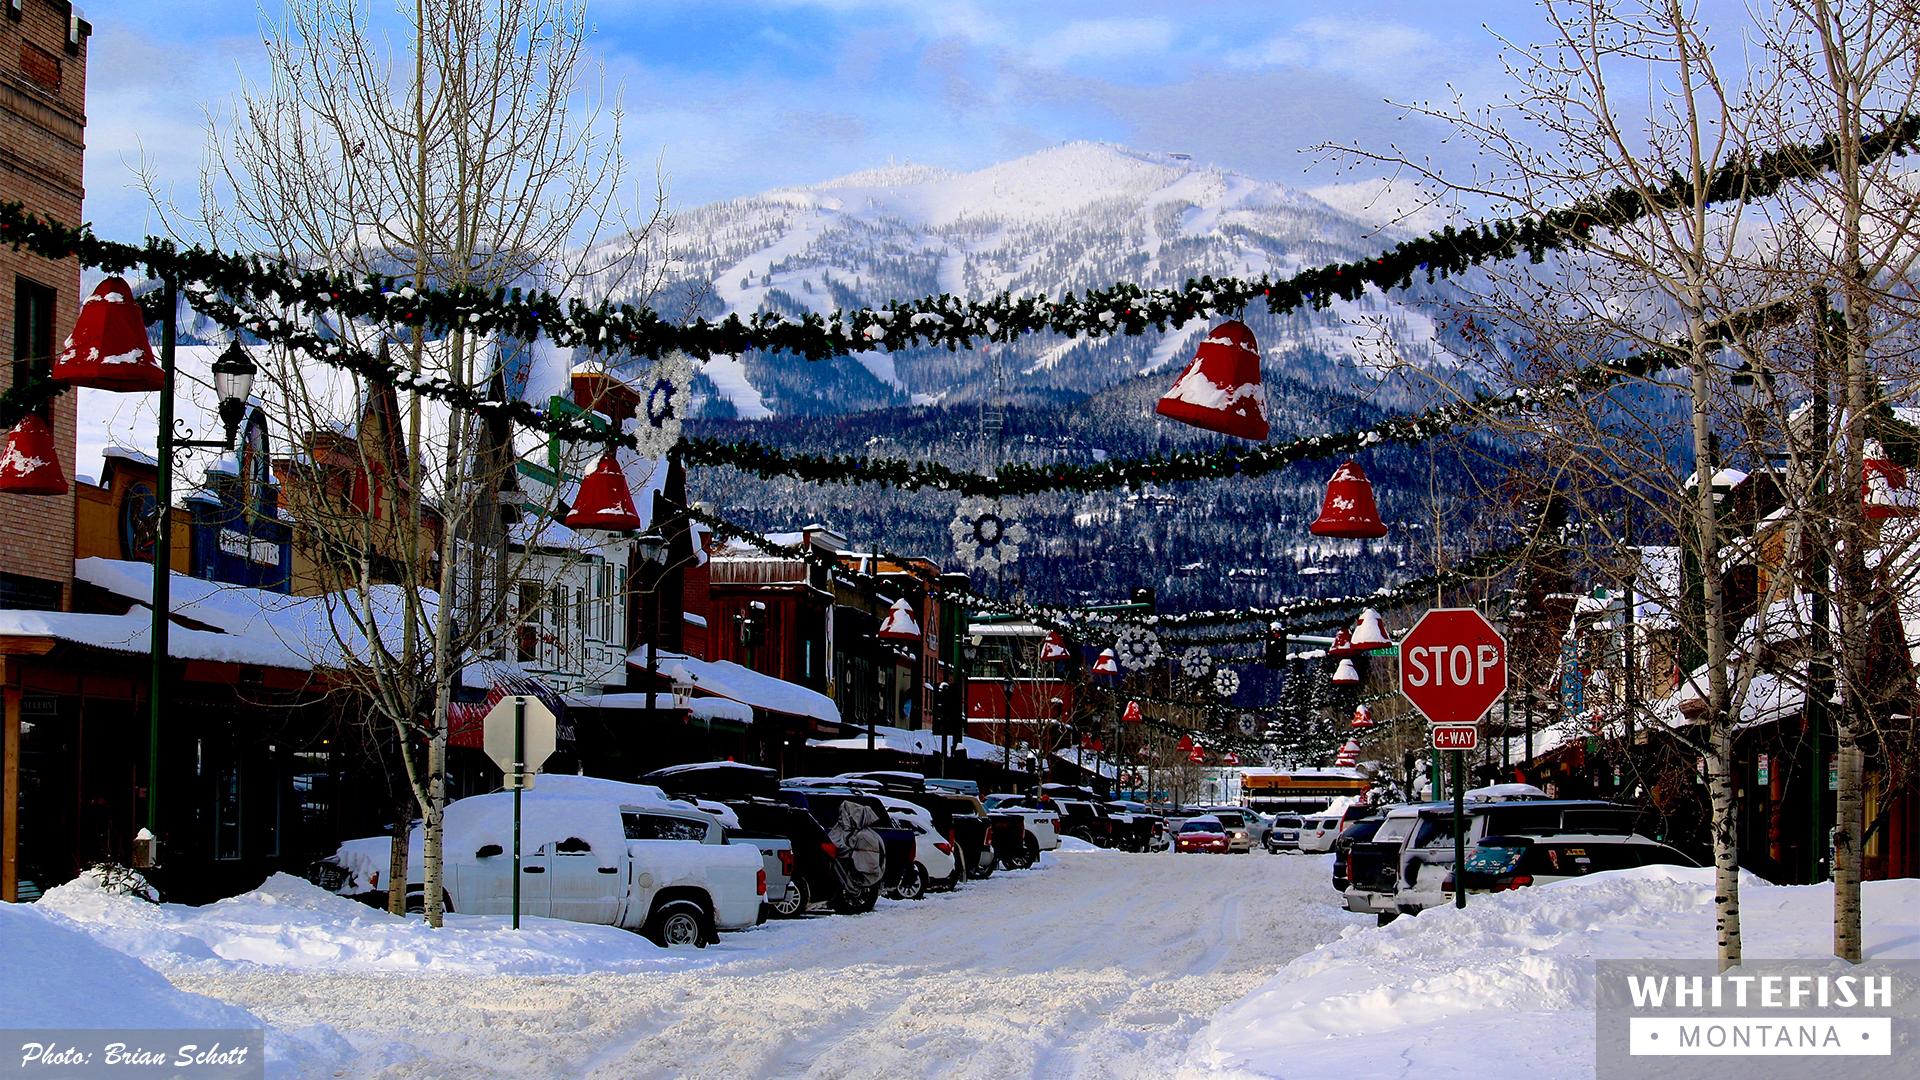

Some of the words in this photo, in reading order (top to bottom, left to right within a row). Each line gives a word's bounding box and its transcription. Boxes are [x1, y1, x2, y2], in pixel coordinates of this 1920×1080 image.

[1381, 647, 1398, 655] SECO
[1408, 644, 1499, 687] STOP
[1436, 731, 1473, 745] 4-WAY
